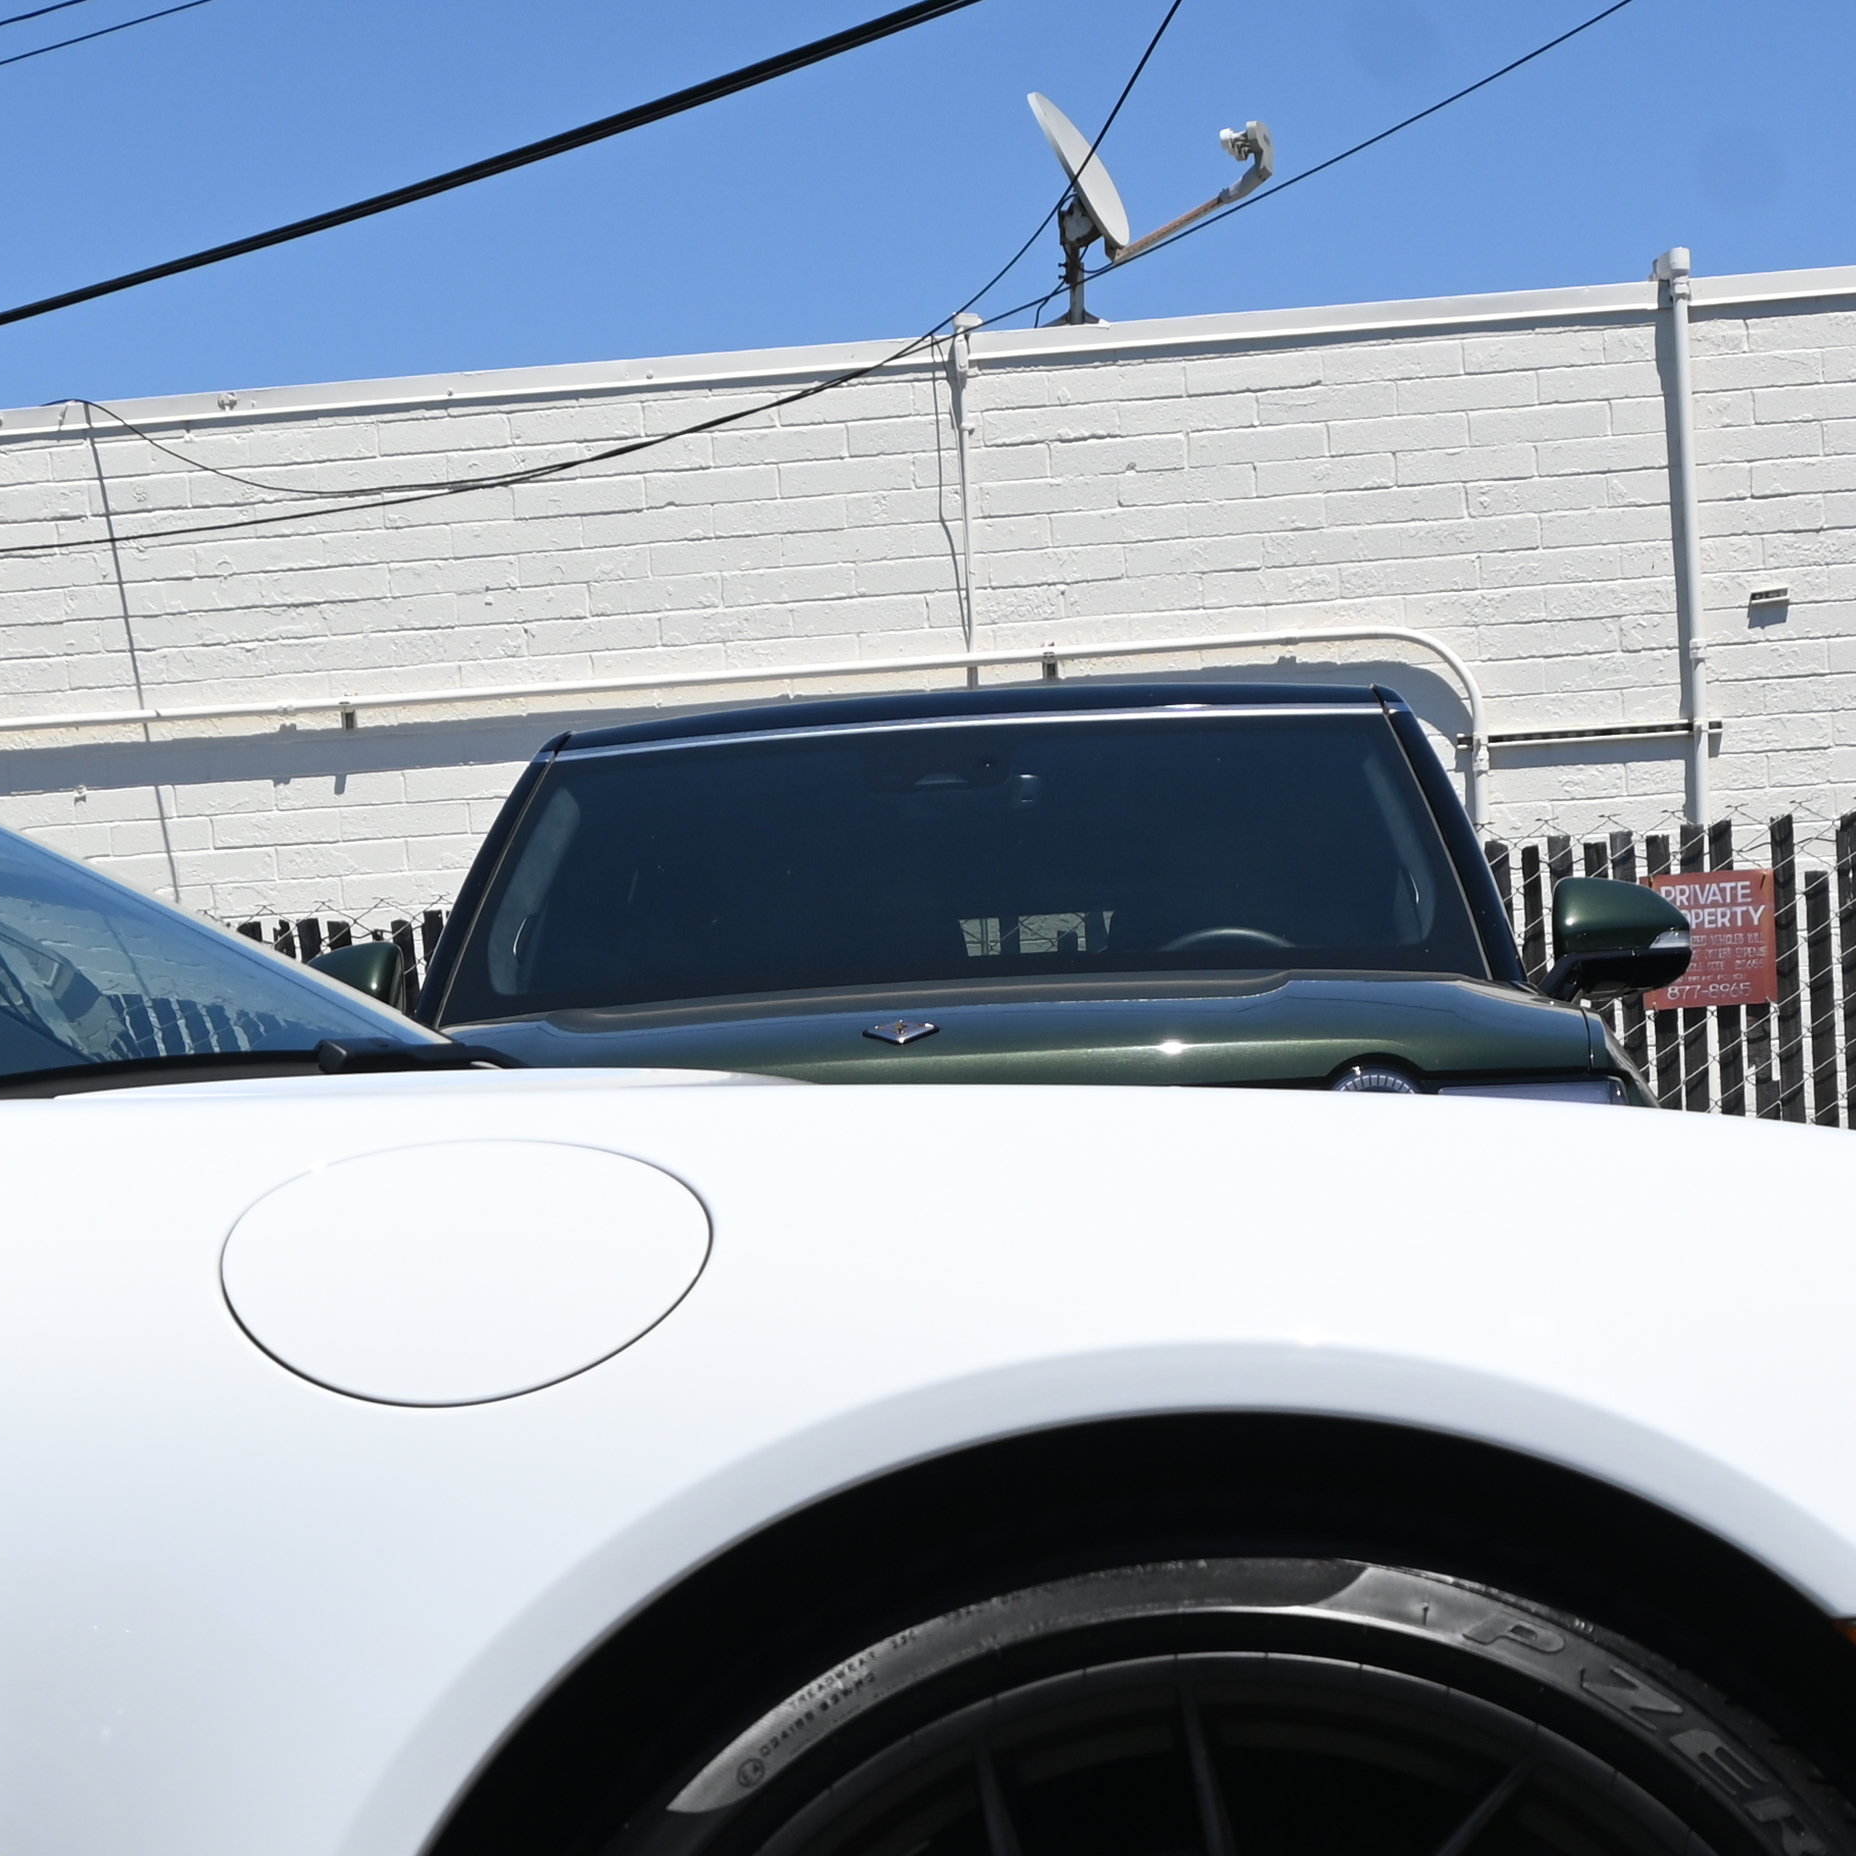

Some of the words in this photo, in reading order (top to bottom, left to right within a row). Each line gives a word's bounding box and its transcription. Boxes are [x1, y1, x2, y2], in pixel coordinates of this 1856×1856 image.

[1660, 881, 1752, 906] PRIVATE
[1681, 904, 1766, 929] PERTY
[1667, 981, 1752, 1000] 877-8965
[1463, 1611, 1565, 1655] P
